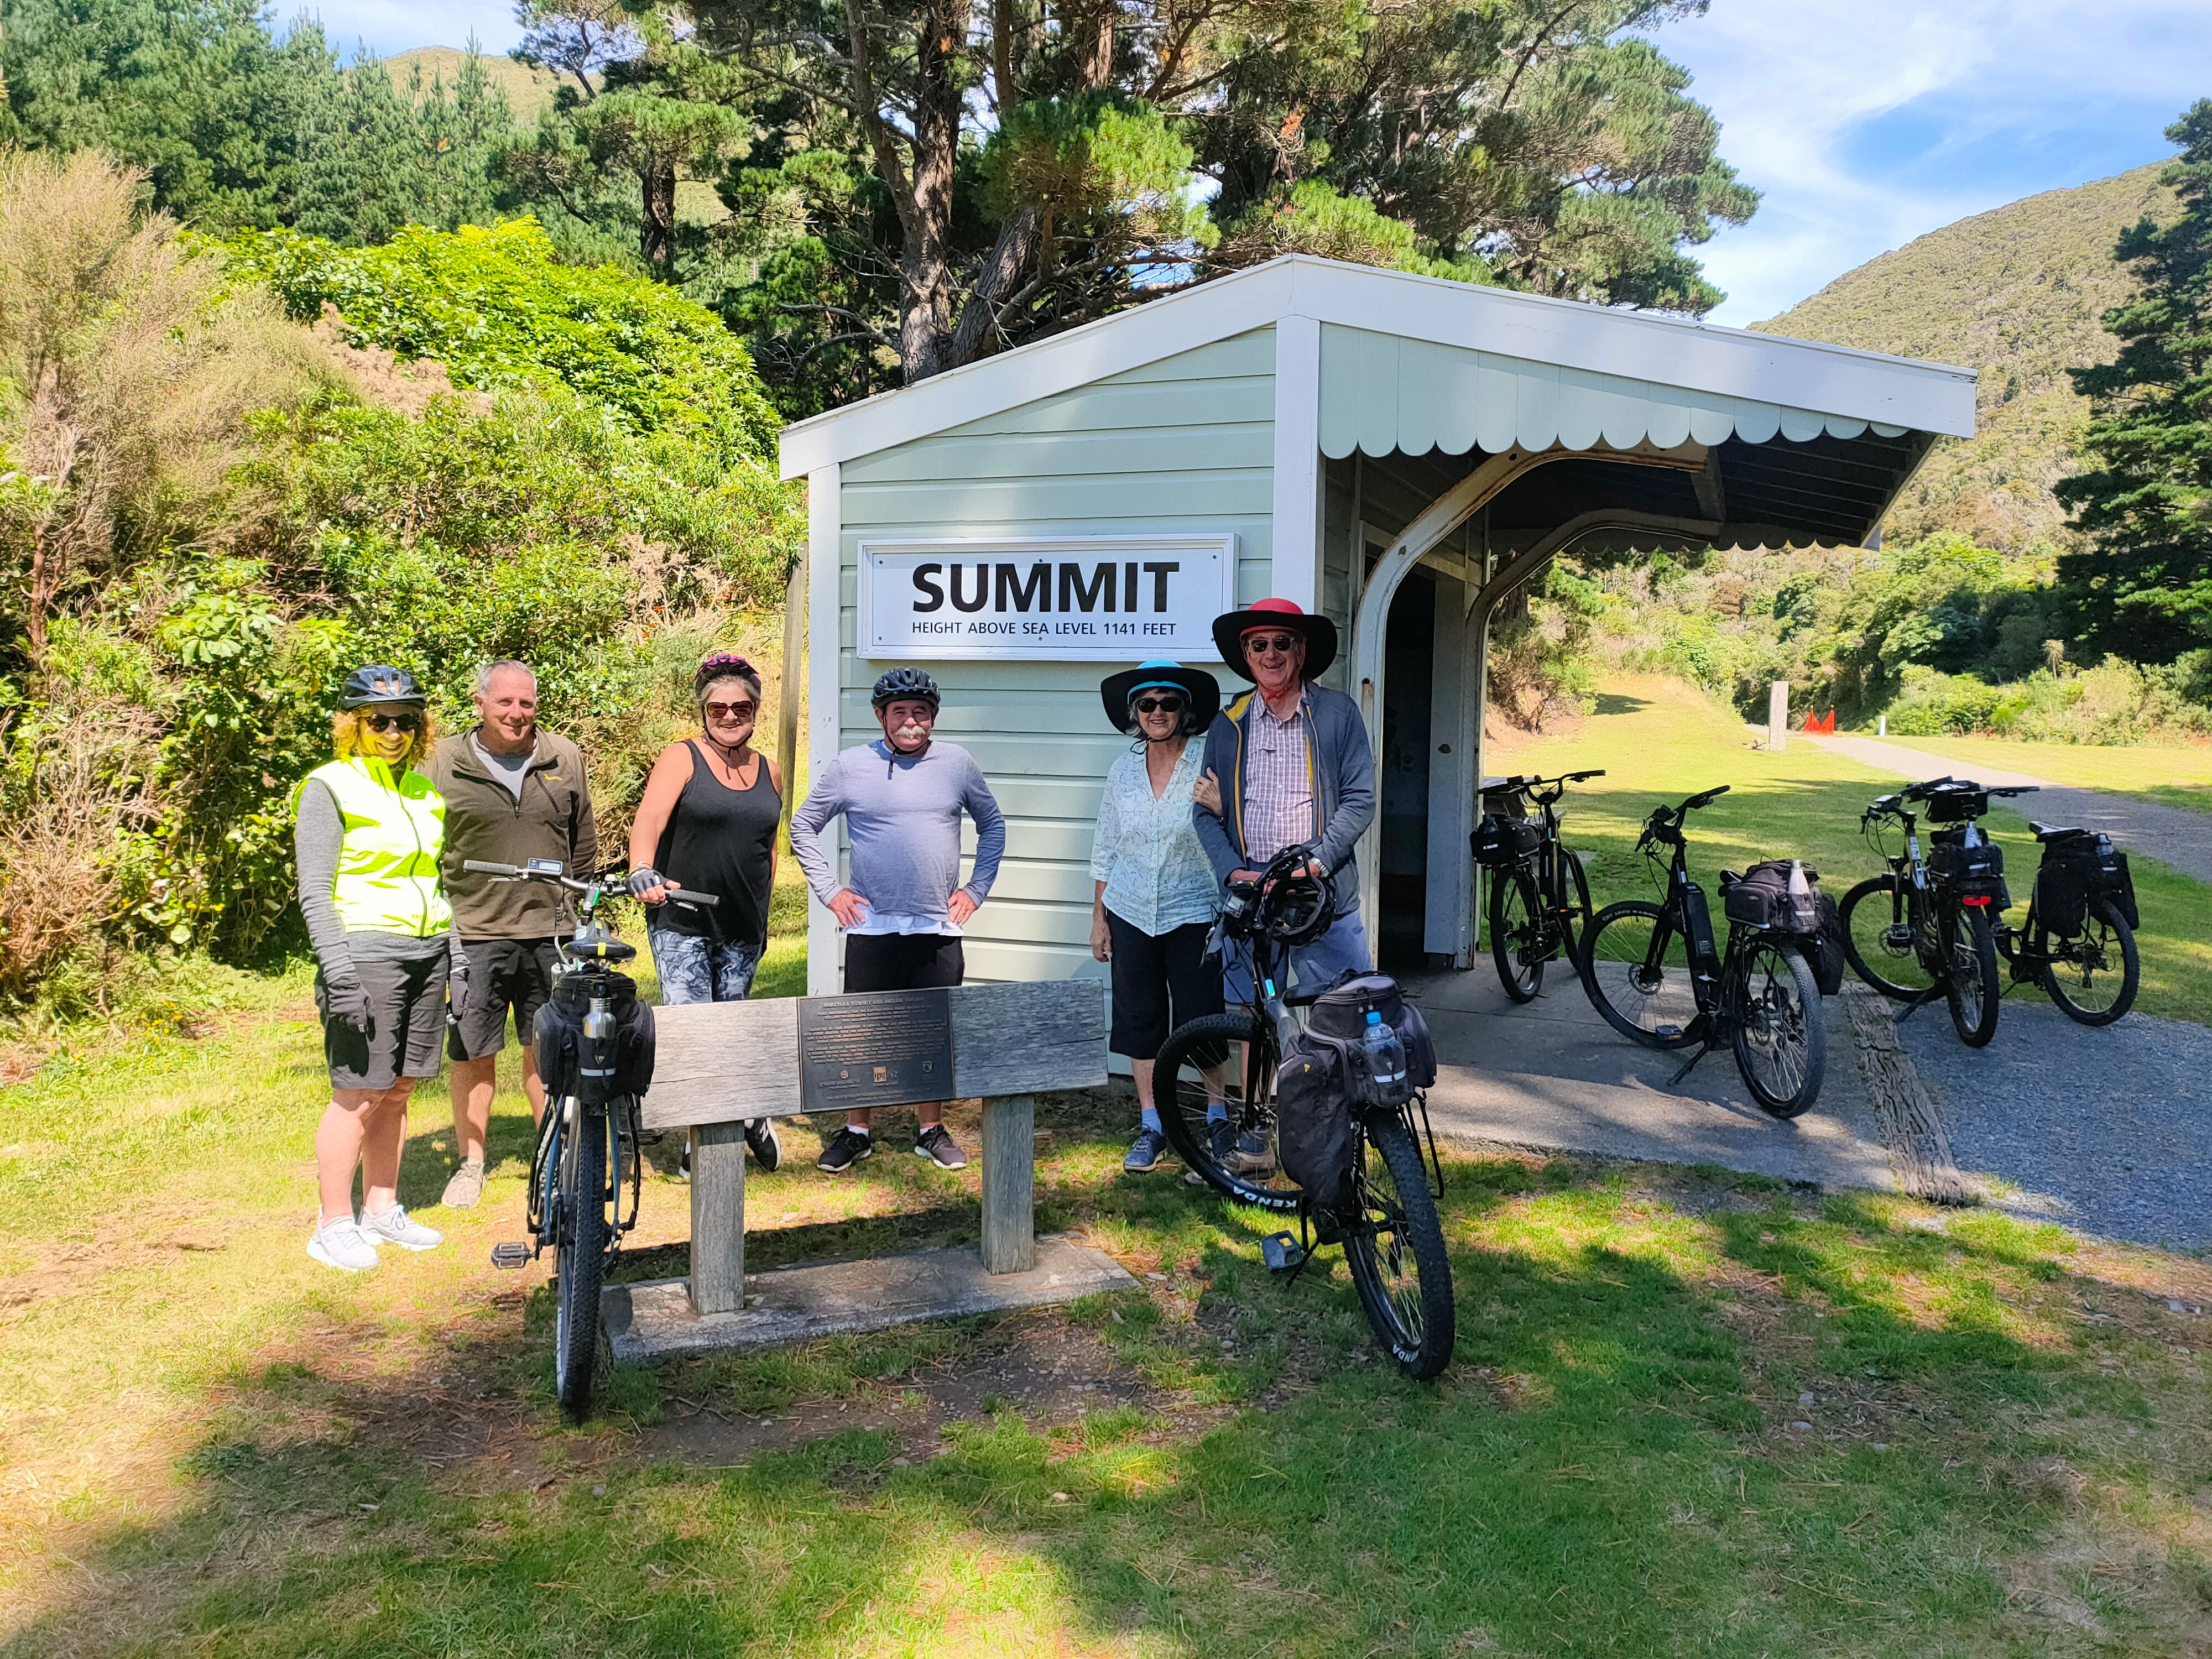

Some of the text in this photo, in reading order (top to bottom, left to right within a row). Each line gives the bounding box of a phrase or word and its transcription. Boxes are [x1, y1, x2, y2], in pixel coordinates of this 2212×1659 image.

[912, 561, 1180, 613] SUMMIT
[912, 622, 1177, 635] HEIGHT ABOVE SEA LEVEL 1141 FEET
[1233, 1185, 1297, 1208] KENDA
